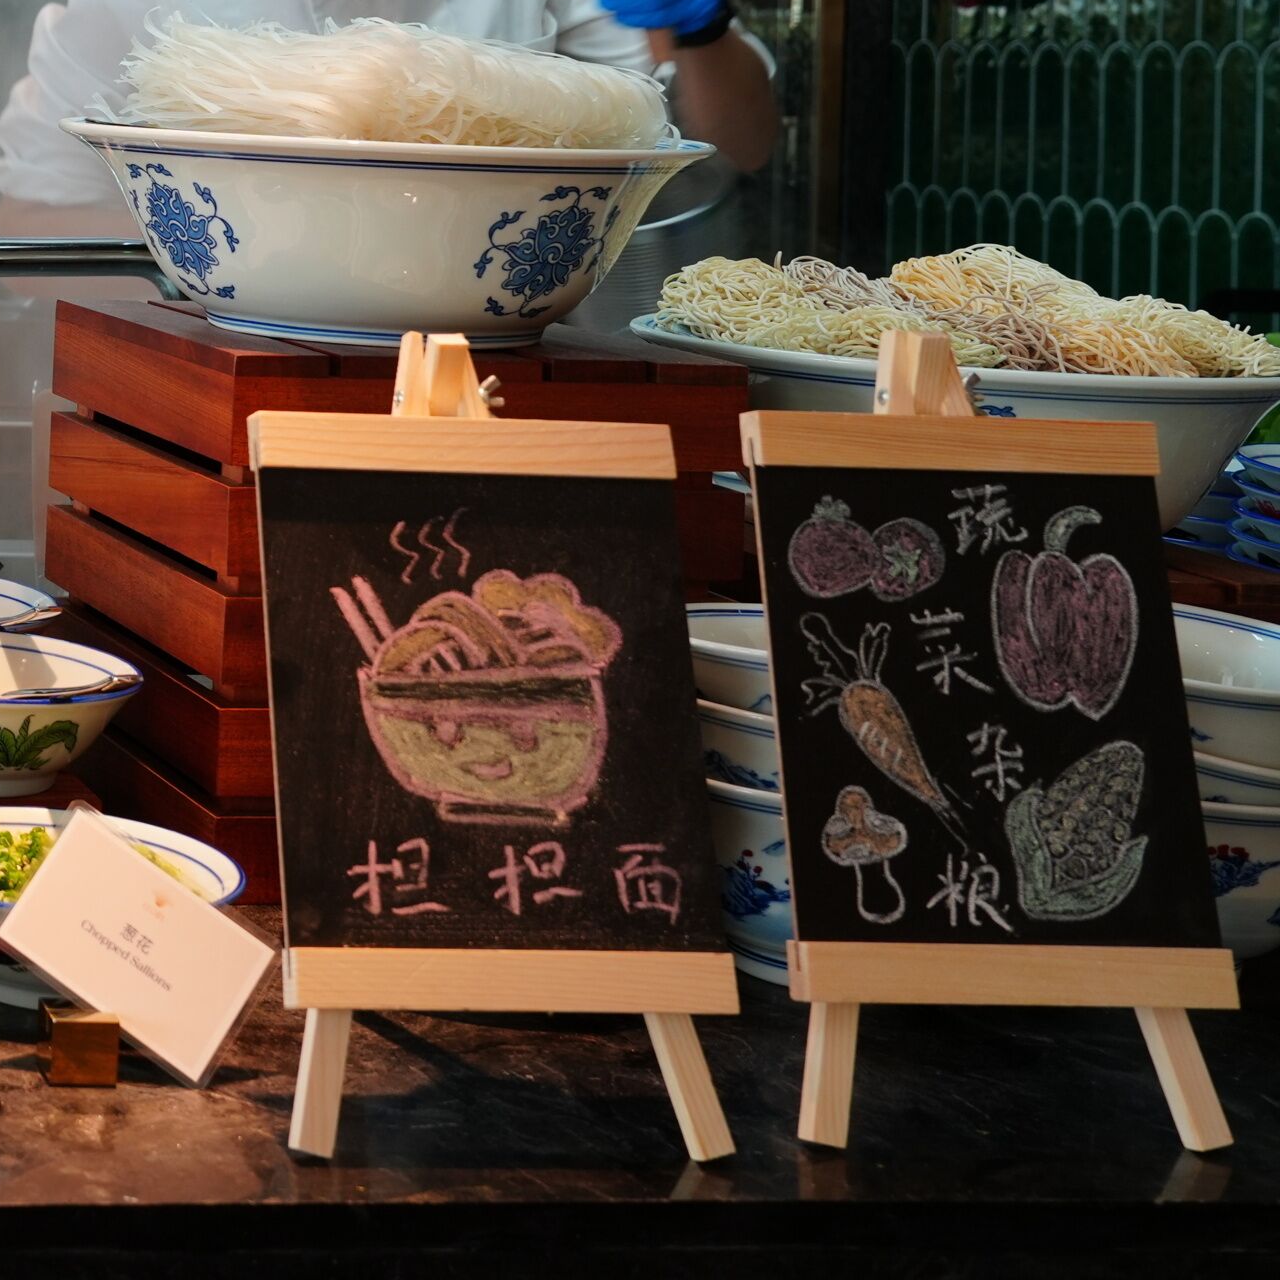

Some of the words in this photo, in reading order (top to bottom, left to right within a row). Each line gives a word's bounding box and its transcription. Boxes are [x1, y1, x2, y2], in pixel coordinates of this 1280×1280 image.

[908, 483, 1029, 933] 蔬菜杂粮
[346, 837, 683, 925] 担担面
[80, 919, 130, 961] Chopped
[119, 923, 154, 955] 葱花
